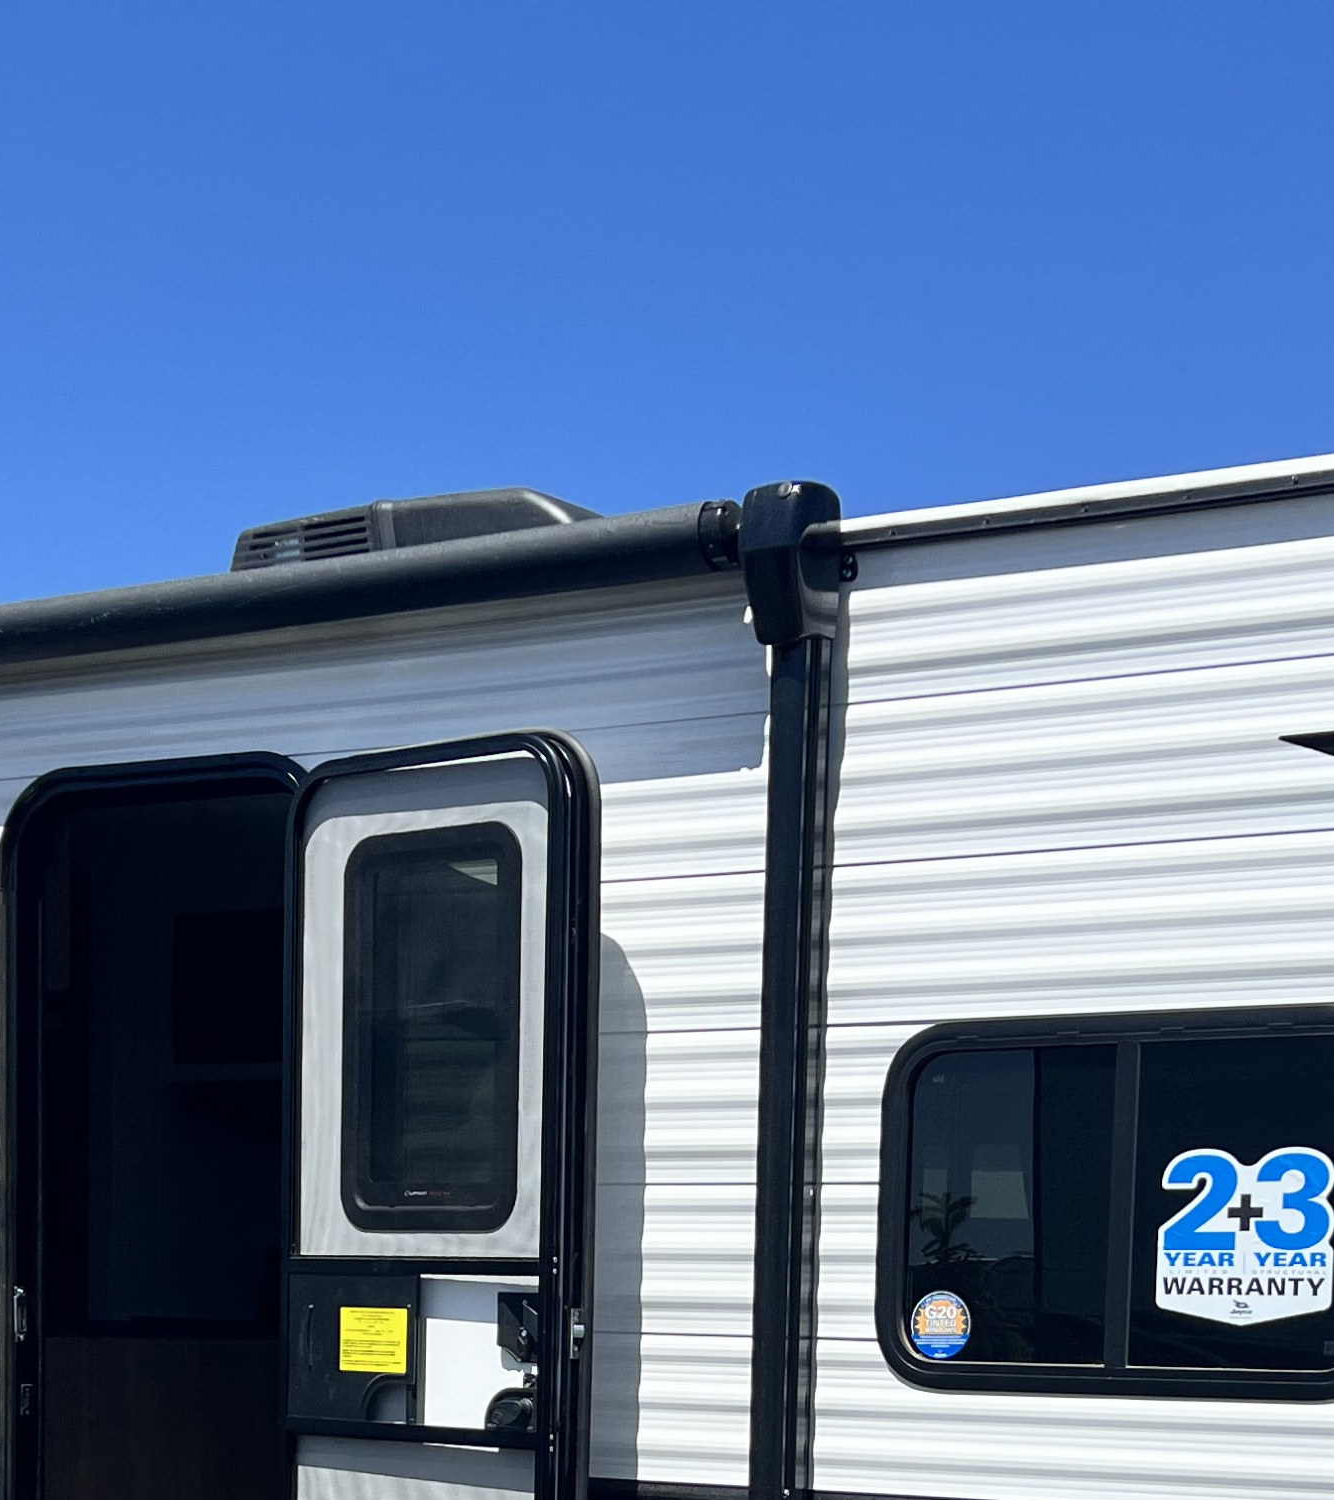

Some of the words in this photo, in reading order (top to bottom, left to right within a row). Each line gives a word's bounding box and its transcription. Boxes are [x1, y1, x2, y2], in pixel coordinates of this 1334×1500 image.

[1164, 1252, 1235, 1267] YEAR
[1253, 1252, 1327, 1268] YEAR
[1163, 1276, 1325, 1297] WARRANTY
[924, 1305, 958, 1319] G20
